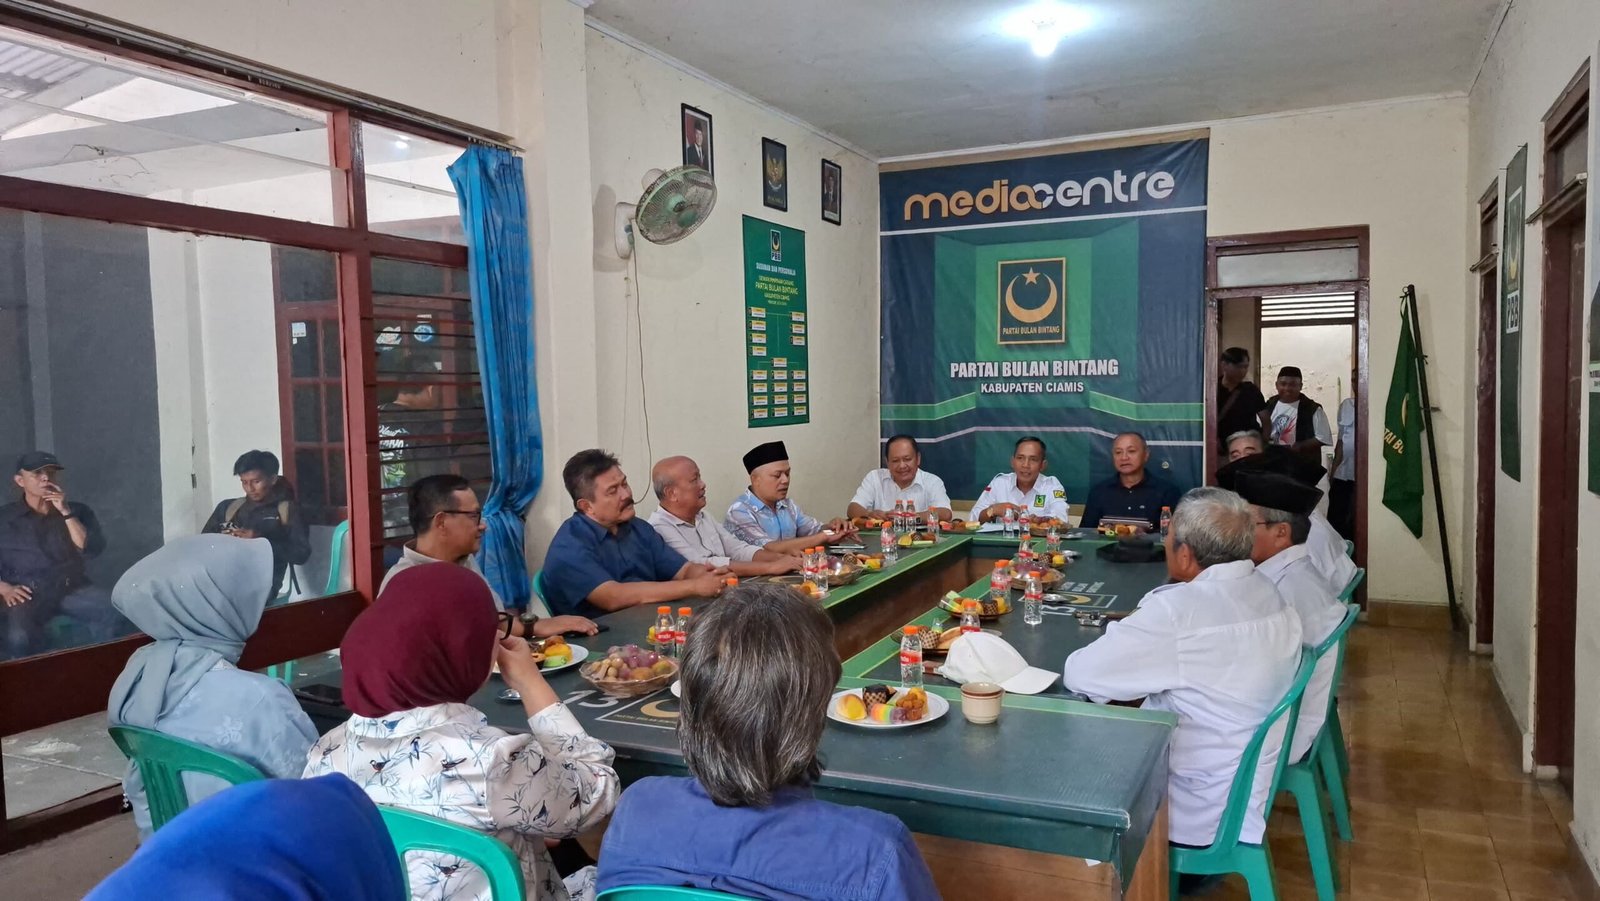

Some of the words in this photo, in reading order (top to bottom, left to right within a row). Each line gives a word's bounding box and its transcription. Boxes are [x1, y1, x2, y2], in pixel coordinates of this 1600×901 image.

[1002, 327, 1020, 335] PARTAI
[1020, 326, 1037, 334] BULAN
[1038, 326, 1060, 334] BINTANG
[950, 362, 998, 378] PARTAI
[1002, 360, 1049, 377] BULAN
[1053, 358, 1119, 376] BINTANG
[980, 382, 1043, 393] KABUPATEN
[1046, 382, 1084, 392] CIAMIS
